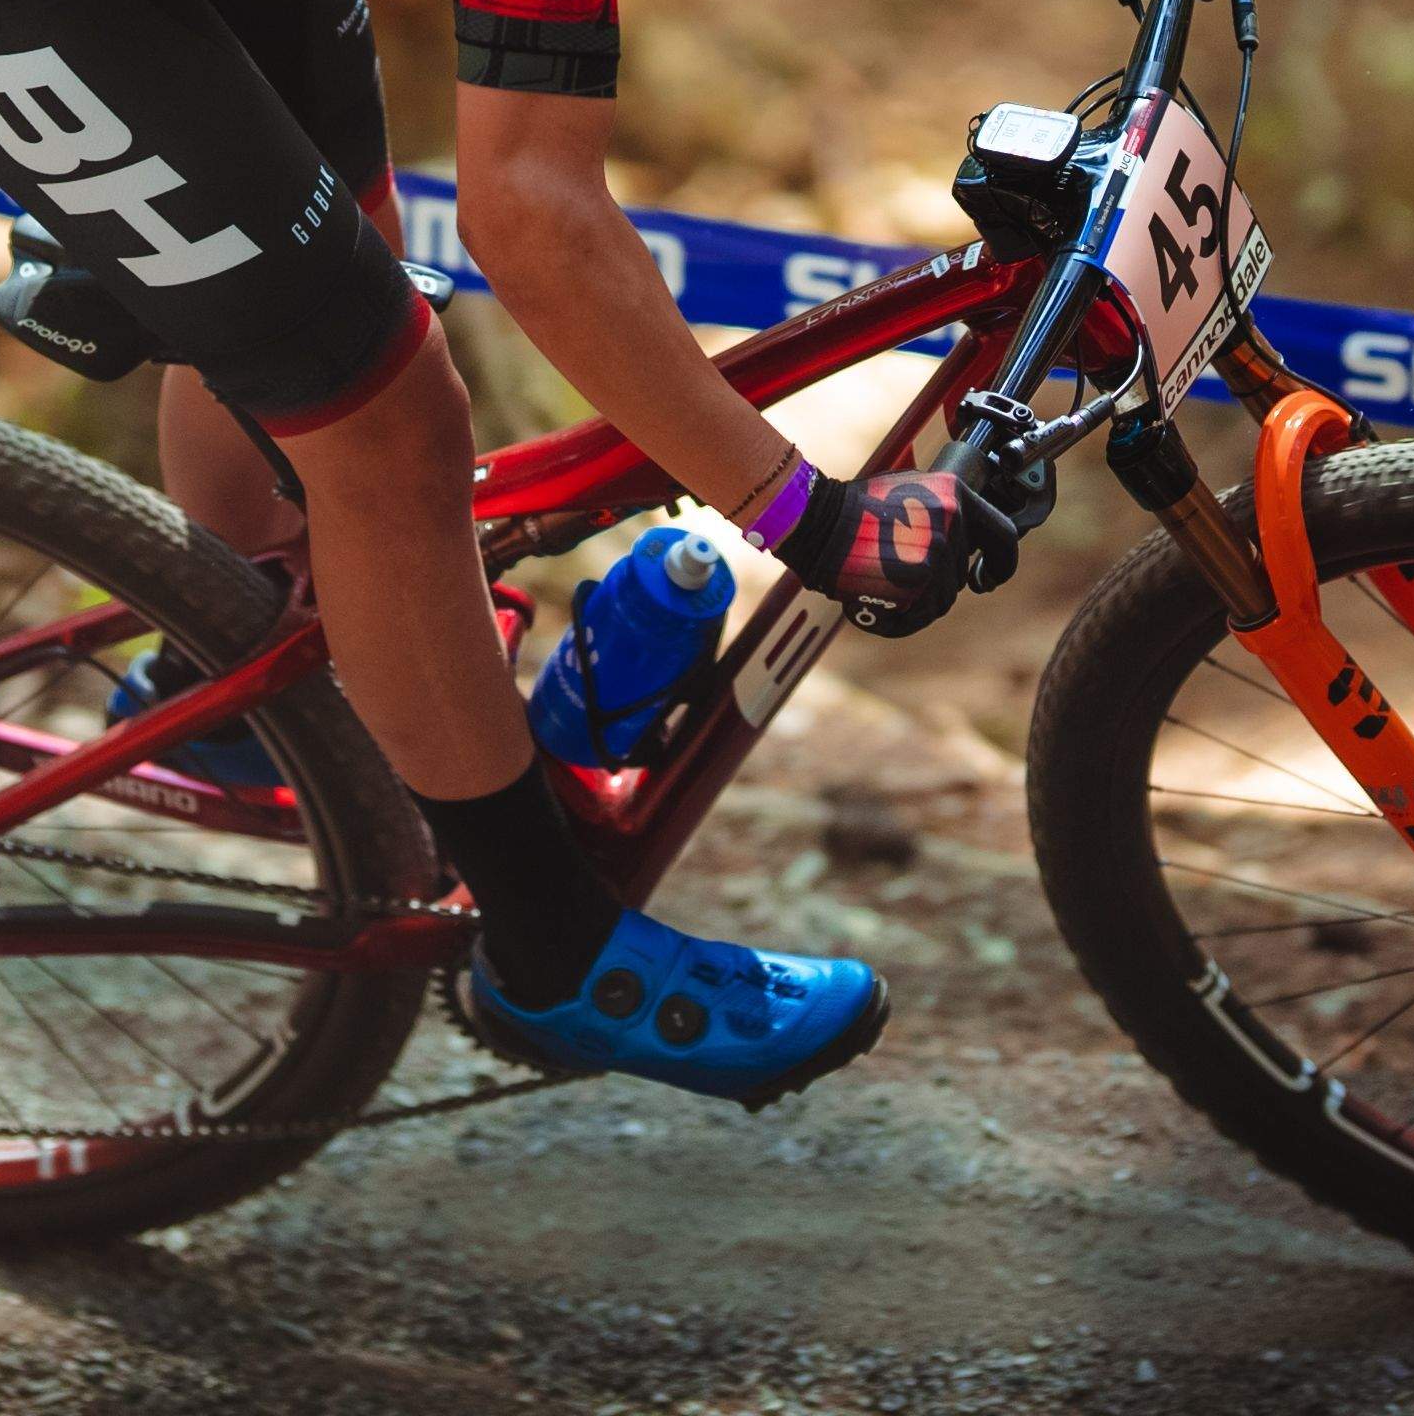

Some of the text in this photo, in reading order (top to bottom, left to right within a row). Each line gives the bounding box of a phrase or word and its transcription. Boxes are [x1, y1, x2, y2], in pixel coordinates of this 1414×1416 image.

[291, 164, 335, 244] GOBIK
[1148, 148, 1222, 314] 45
[18, 316, 98, 356] prologo
